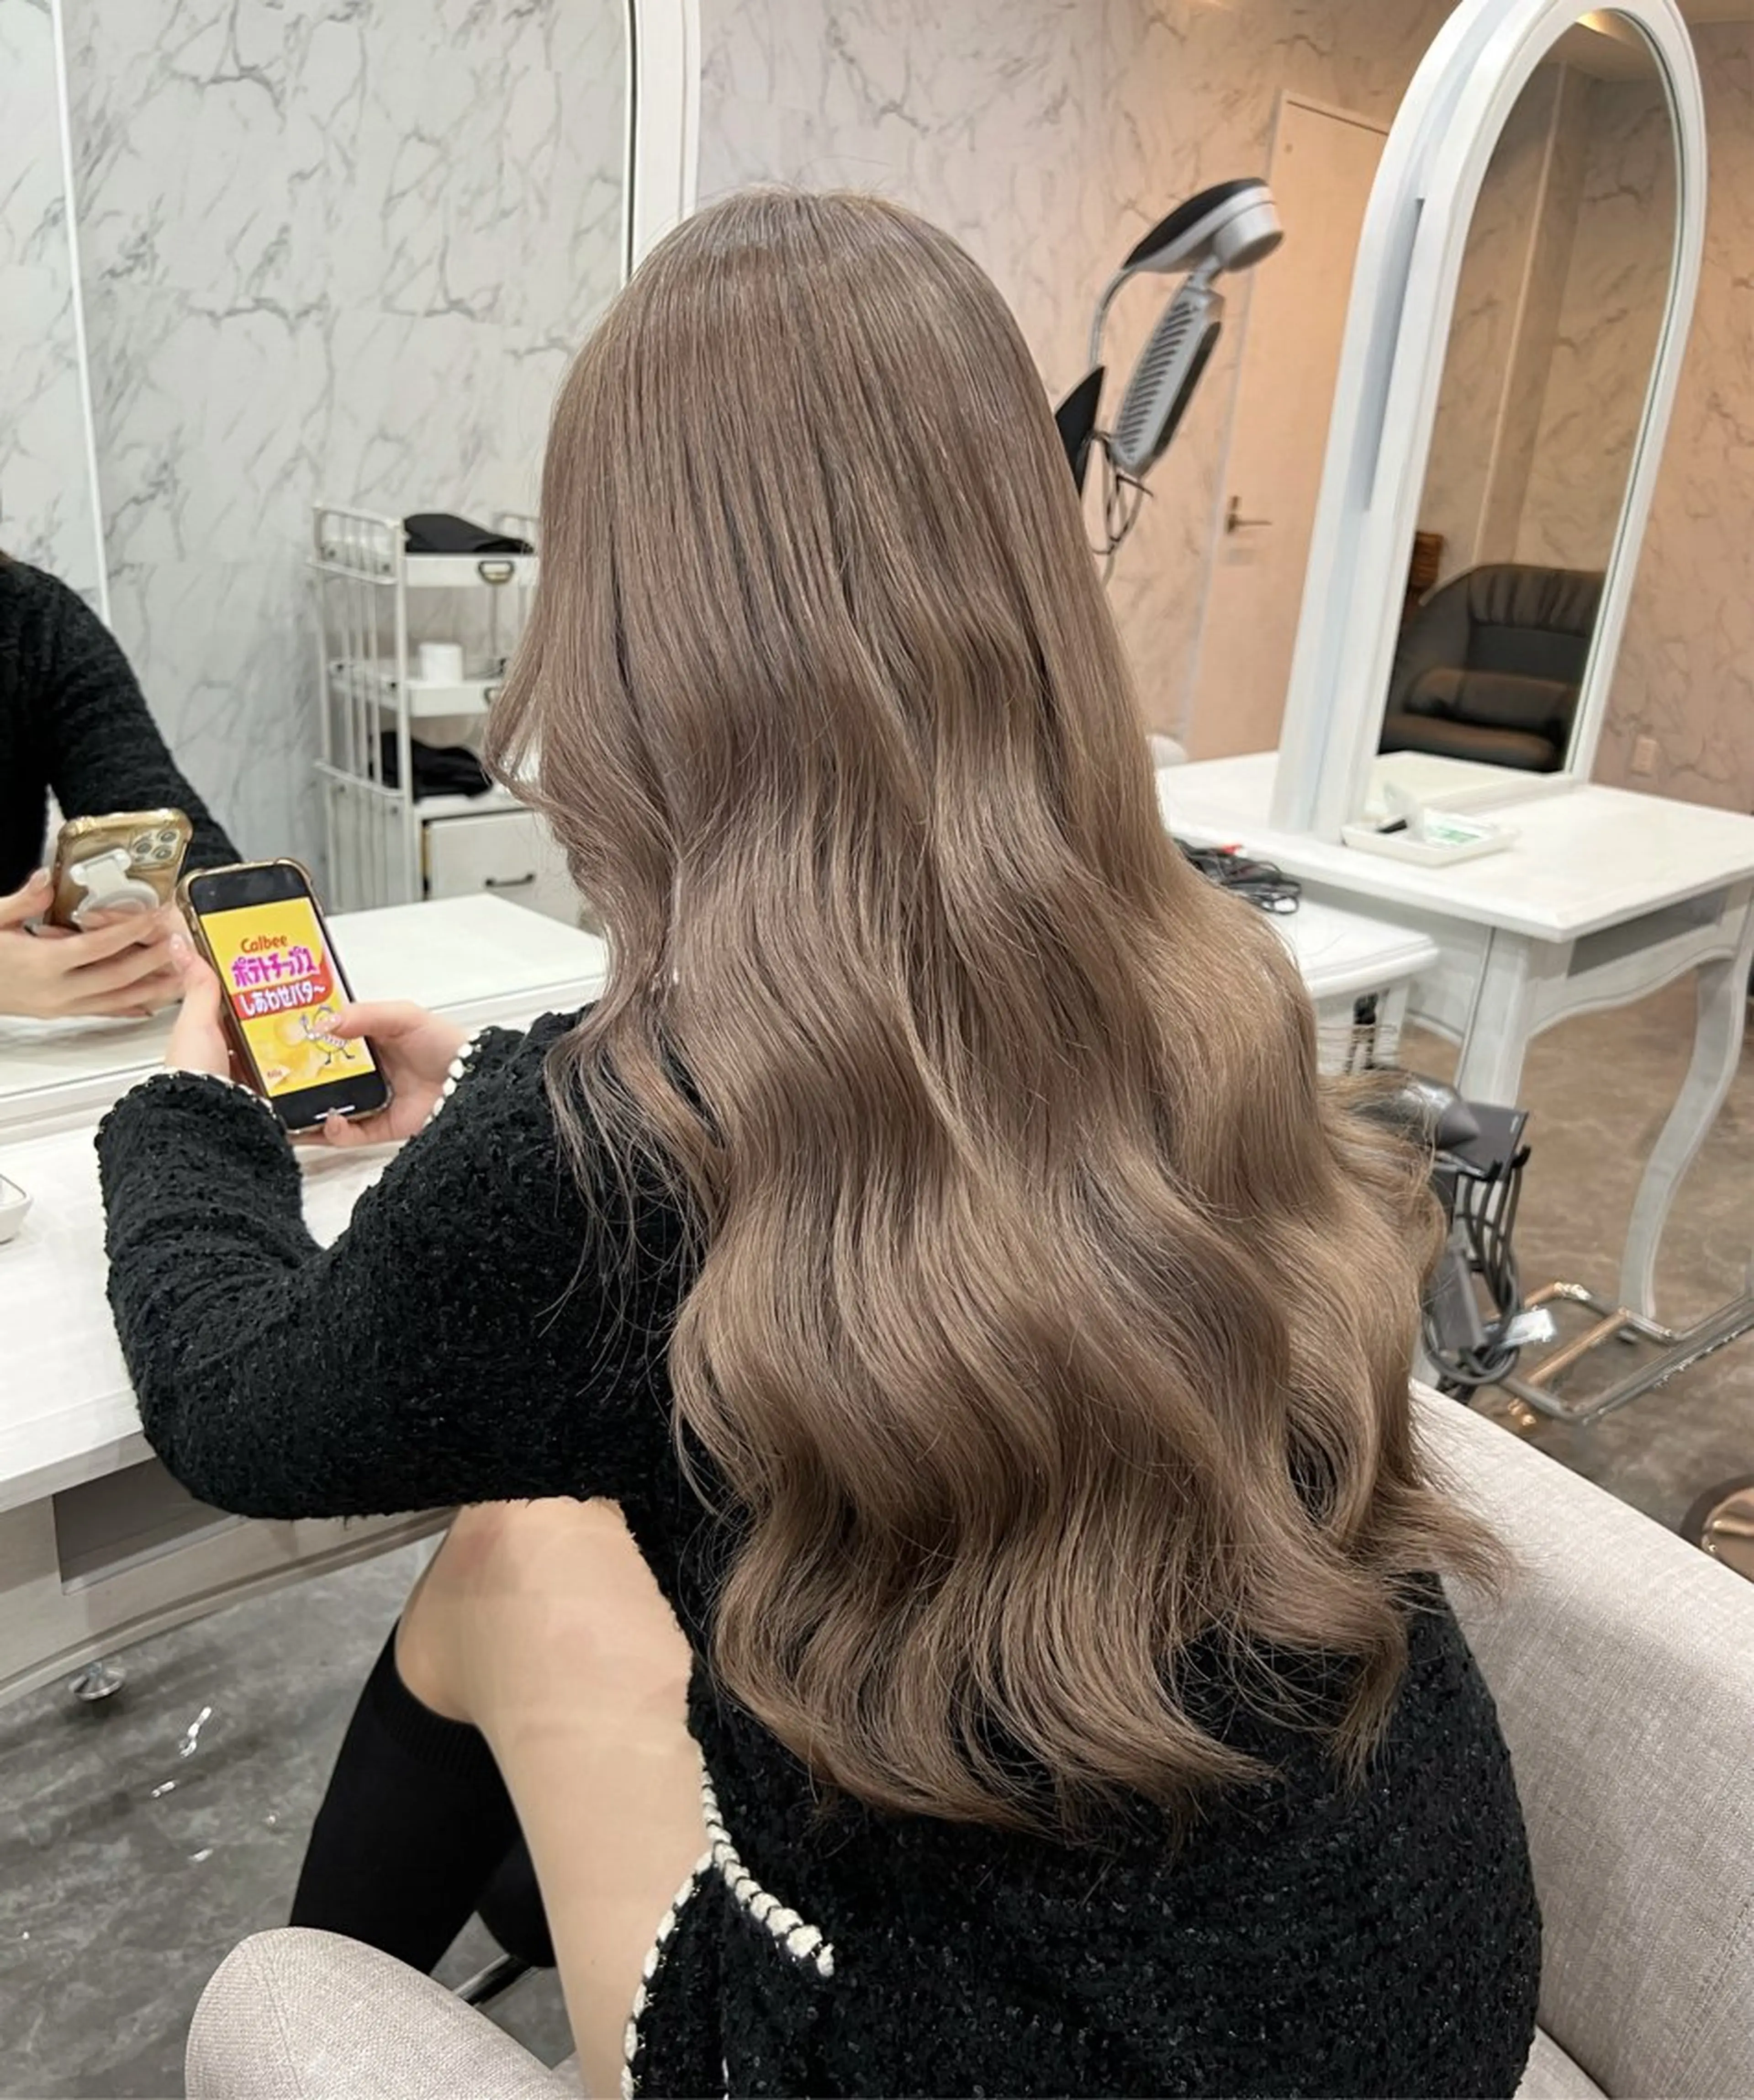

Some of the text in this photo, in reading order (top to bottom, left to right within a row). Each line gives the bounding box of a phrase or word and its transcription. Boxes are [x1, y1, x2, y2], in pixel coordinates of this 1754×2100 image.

[241, 935, 287, 953] Calbee
[232, 946, 317, 987] ポテトチップス
